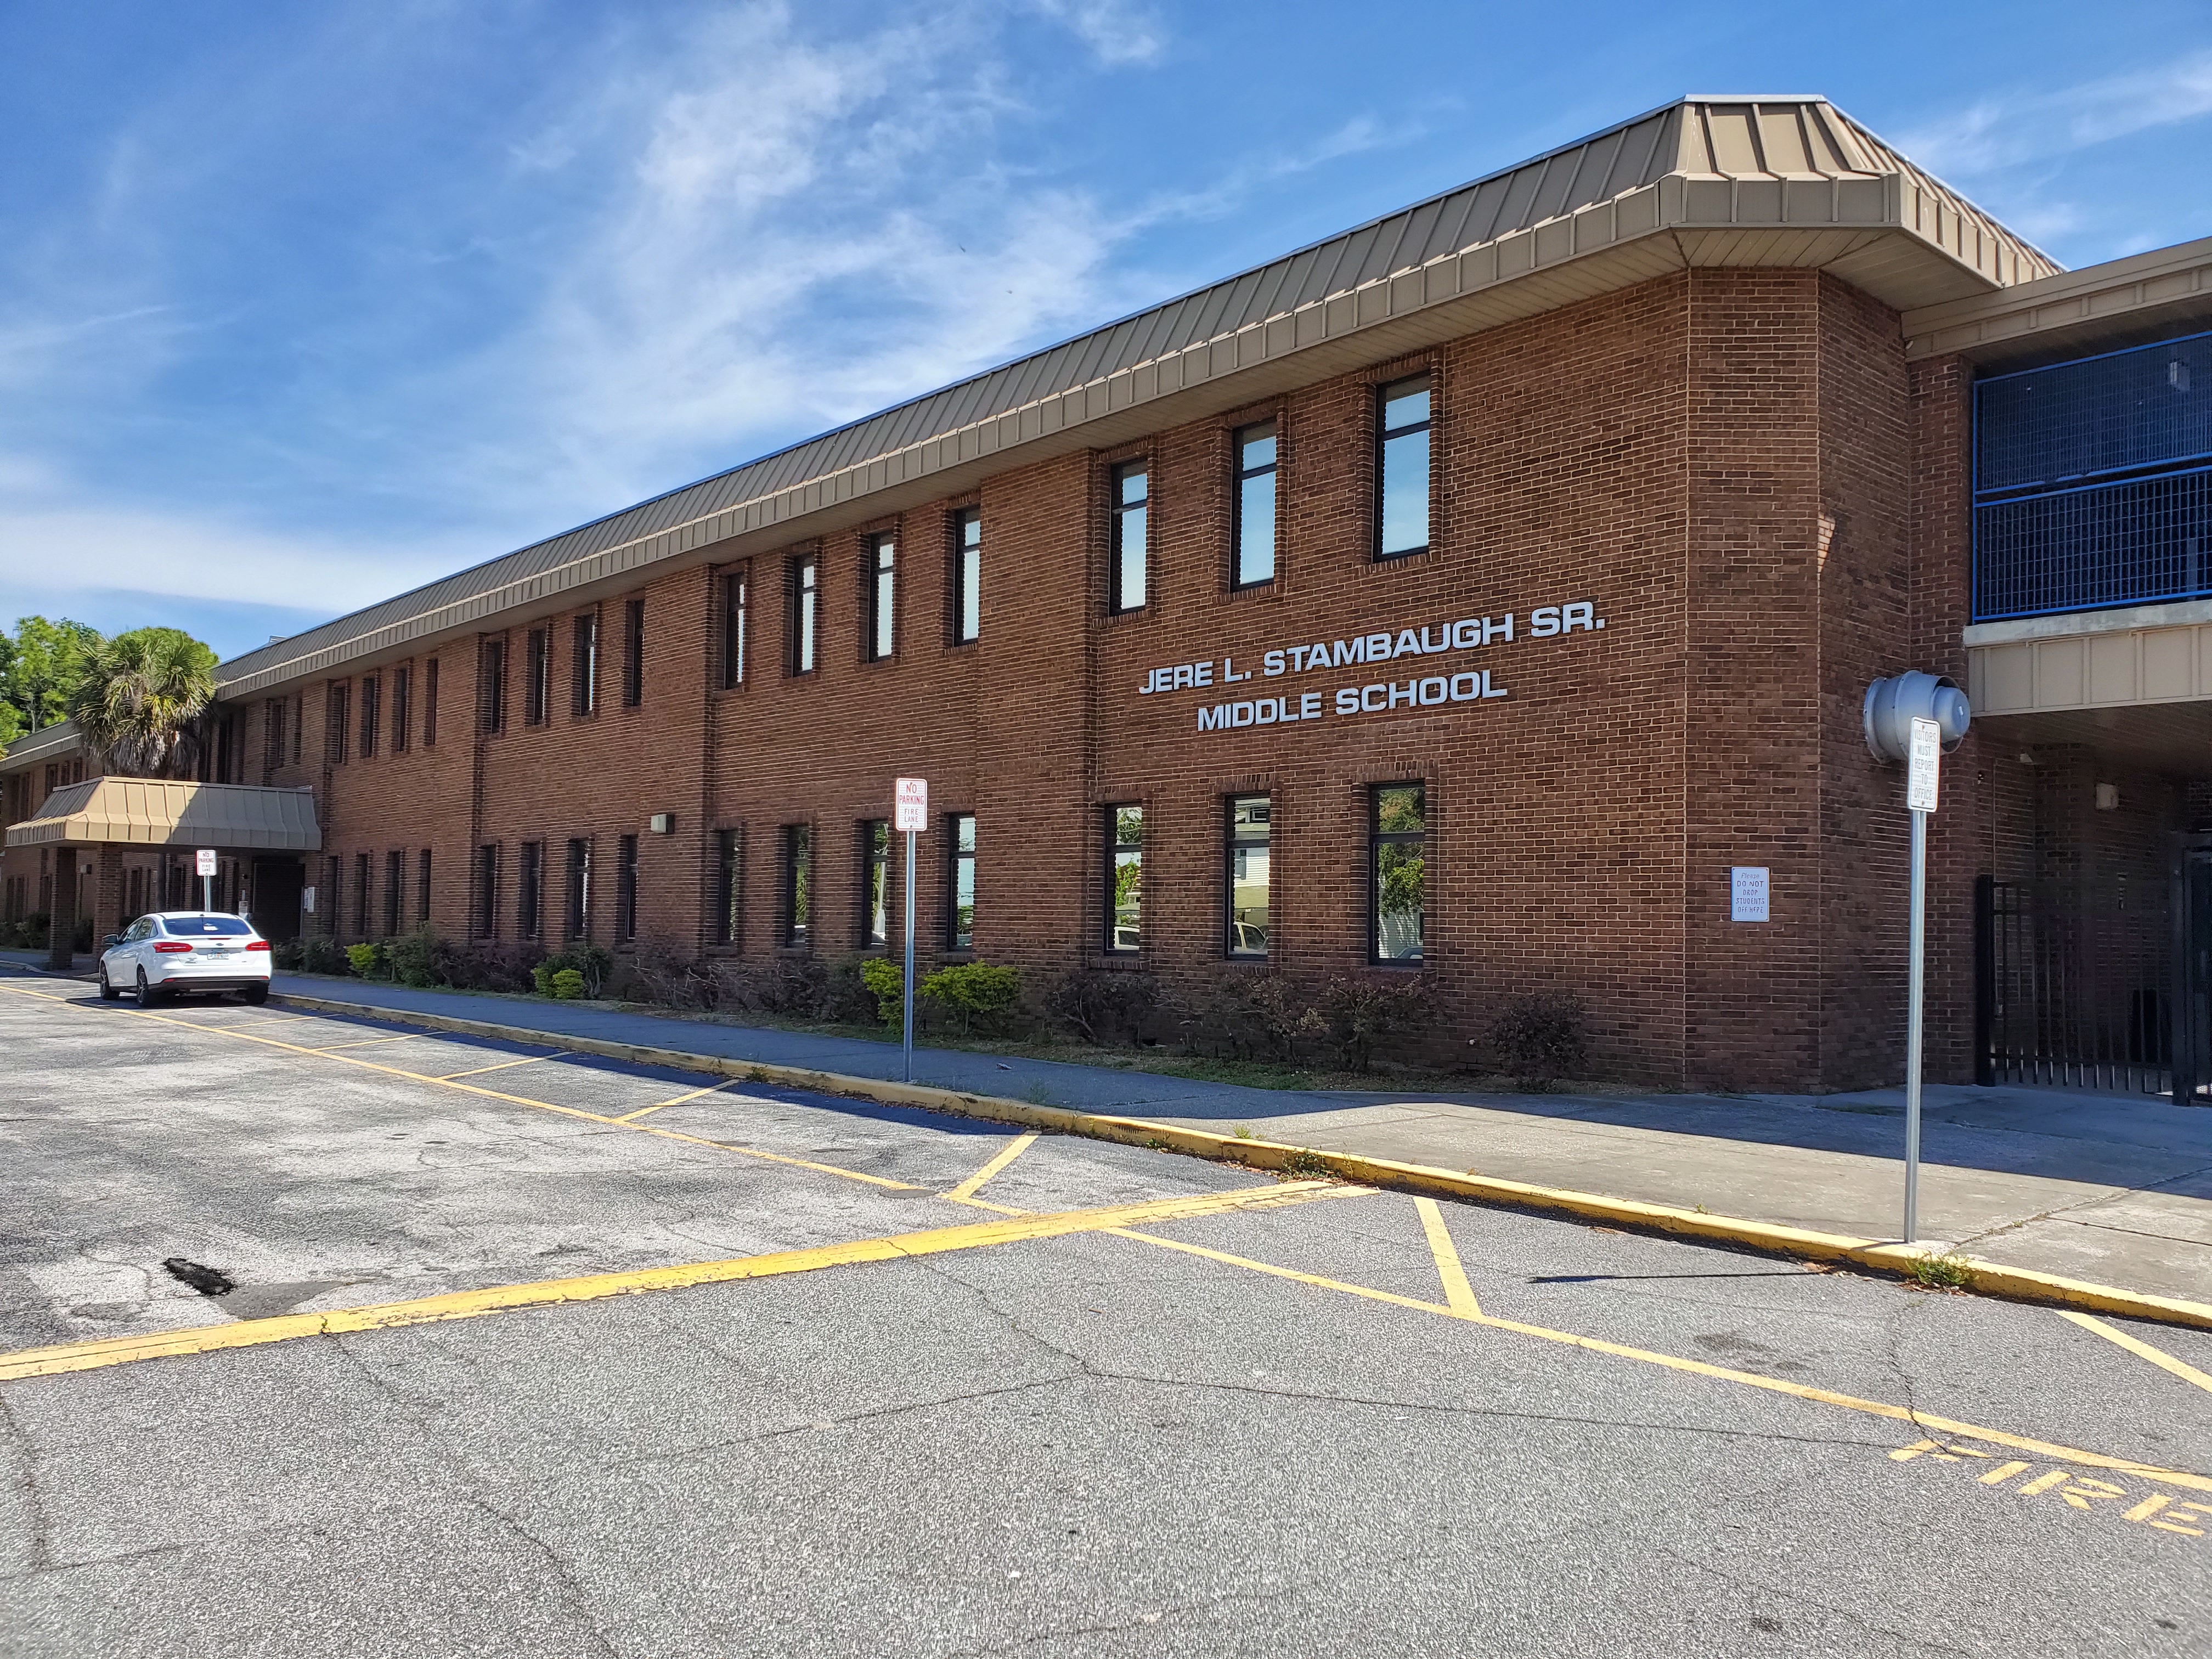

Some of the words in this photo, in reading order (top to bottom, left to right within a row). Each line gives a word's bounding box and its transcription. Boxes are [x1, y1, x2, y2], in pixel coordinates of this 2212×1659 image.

[1139, 661, 1214, 694] JERE
[1224, 657, 1252, 682] L.
[1263, 613, 1514, 677] STAMBAUGH
[1530, 601, 1606, 638] SR.
[1198, 692, 1323, 732] MIDDLE
[1335, 669, 1508, 715] SCHOOL
[1914, 728, 1936, 743] VISITORS
[1917, 743, 1931, 757] MUST
[1915, 758, 1934, 771] REPORT
[1921, 774, 1928, 785] TO
[906, 784, 917, 793] NO
[1914, 787, 1932, 800] OFFICE
[899, 795, 924, 805] PARKING
[1888, 1438, 2212, 1537] FIRE
